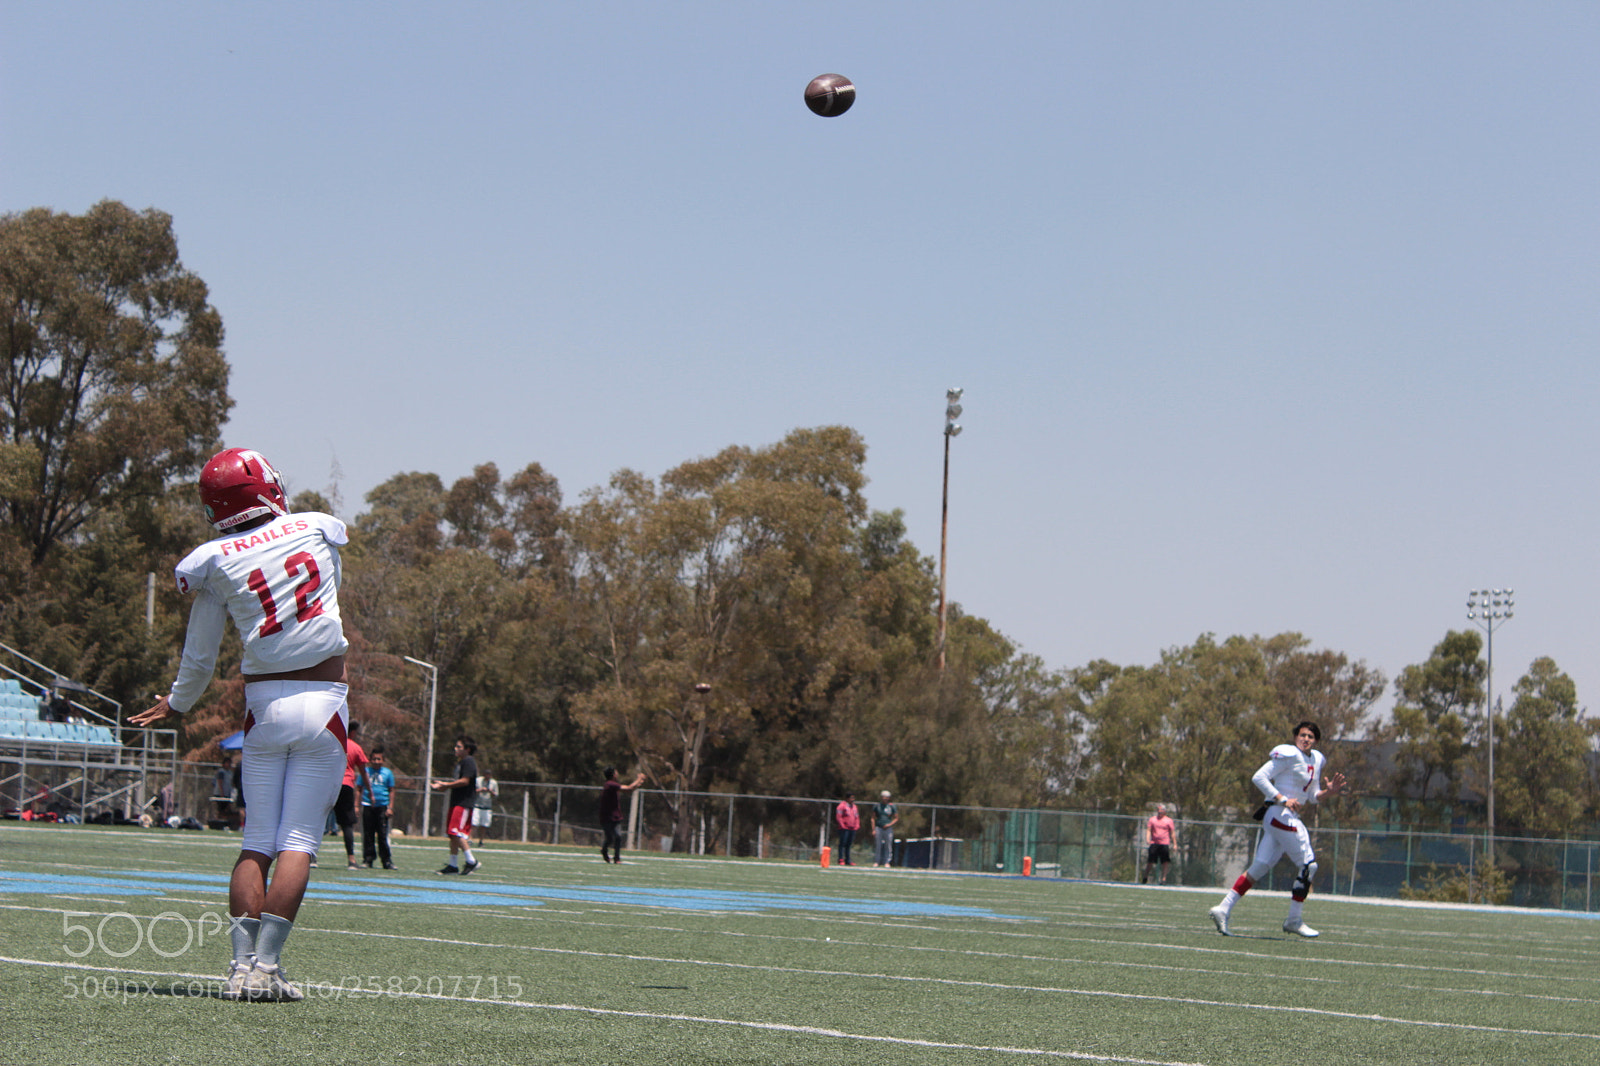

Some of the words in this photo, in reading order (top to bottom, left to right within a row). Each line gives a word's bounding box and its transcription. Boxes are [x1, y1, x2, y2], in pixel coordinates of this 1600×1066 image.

[219, 513, 250, 529] Riddell
[220, 520, 309, 556] FRAILES
[247, 551, 326, 638] 12
[1303, 765, 1314, 792] 7
